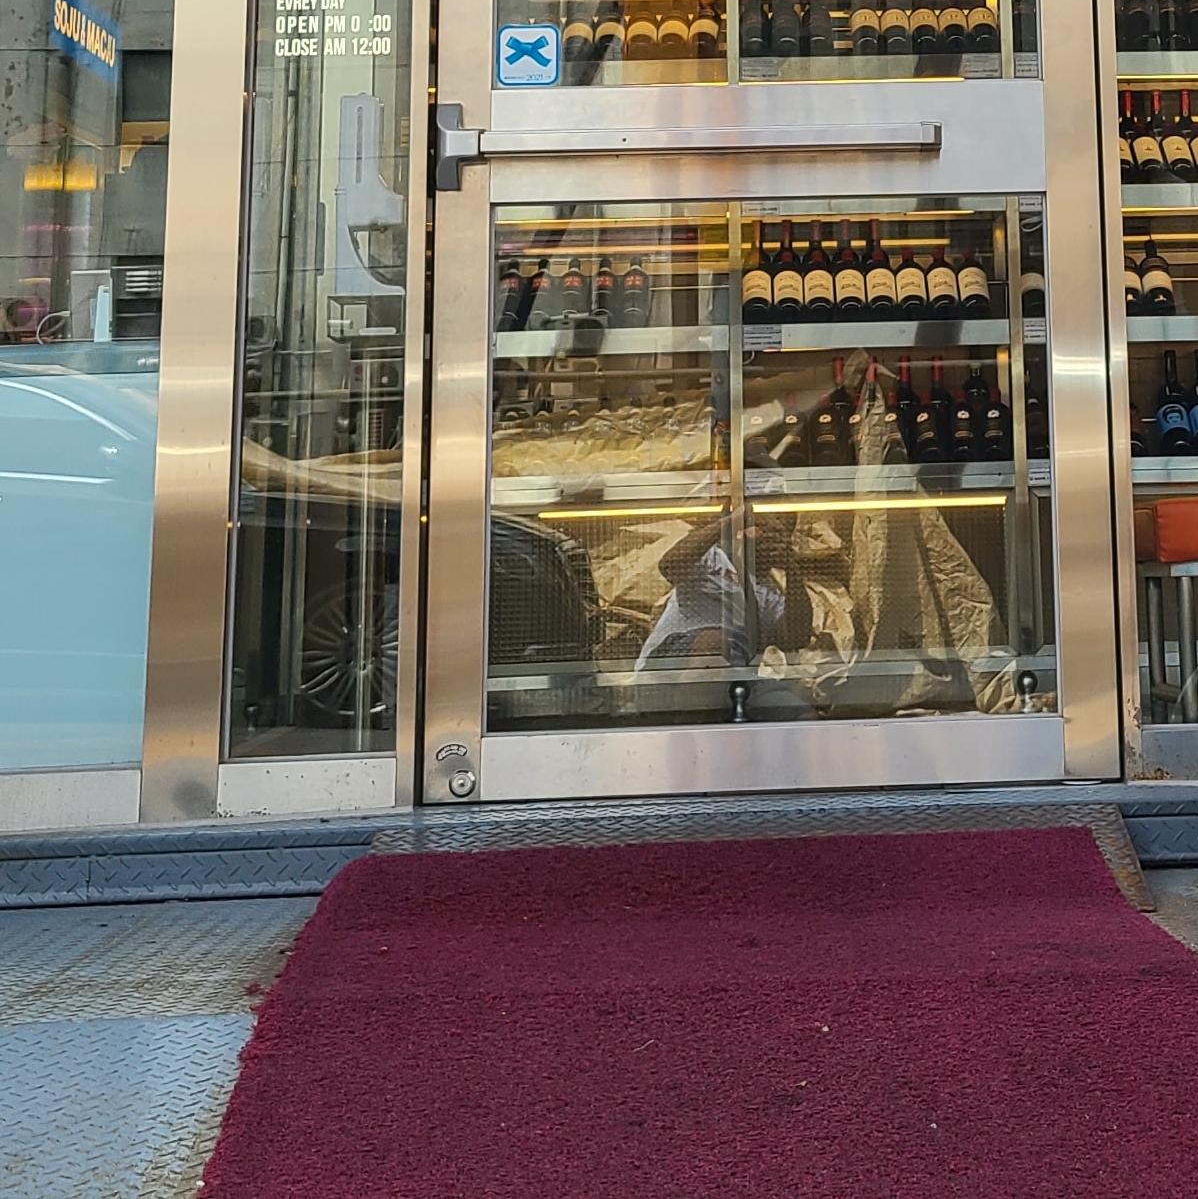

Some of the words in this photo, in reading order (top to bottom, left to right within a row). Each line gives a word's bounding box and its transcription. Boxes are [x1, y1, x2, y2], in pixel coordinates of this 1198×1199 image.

[275, 15, 319, 34] OPEN
[324, 14, 346, 33] PM
[86, 19, 116, 68] MACJU
[274, 37, 319, 56] CLOSE
[324, 37, 346, 56] AM
[351, 36, 391, 56] 12:00
